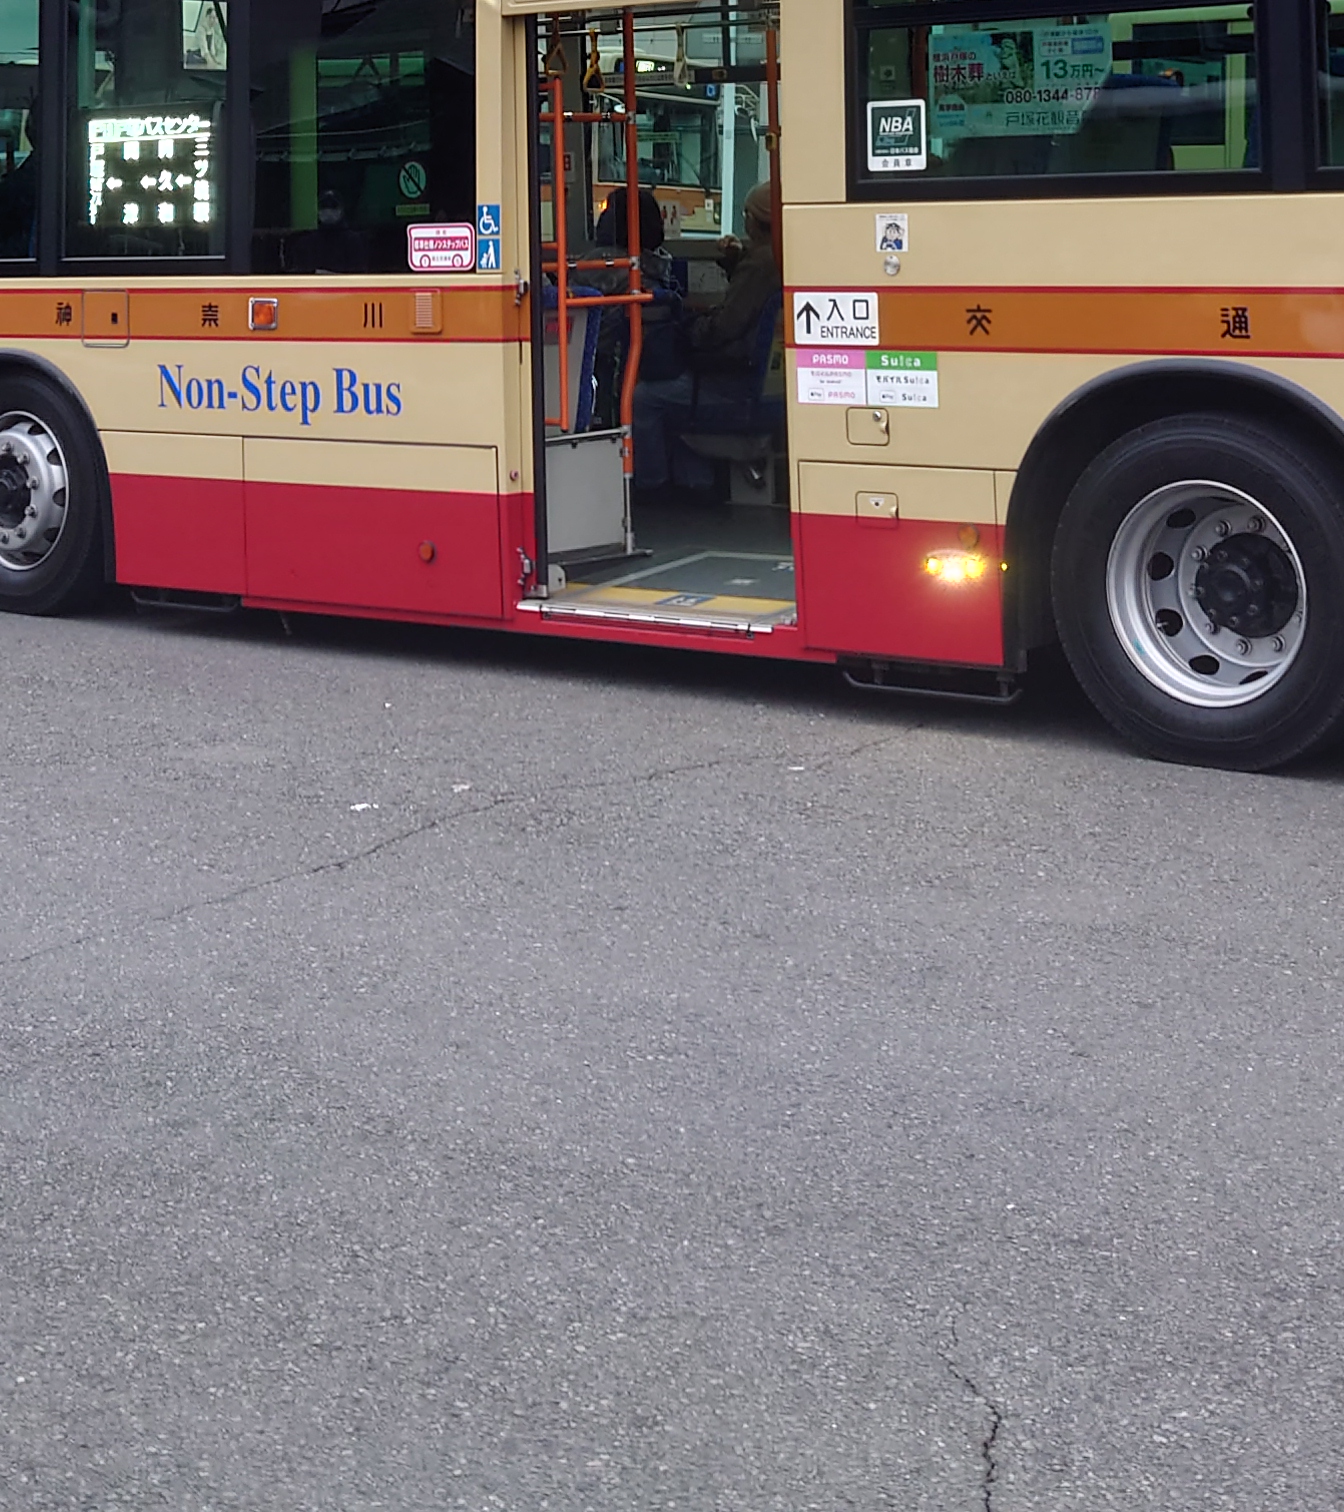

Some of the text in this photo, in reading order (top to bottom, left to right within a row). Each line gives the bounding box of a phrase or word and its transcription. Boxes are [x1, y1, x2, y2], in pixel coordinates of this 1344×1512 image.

[878, 116, 914, 133] NBA
[826, 298, 870, 321] 入口
[820, 325, 877, 339] ENTRANCE
[812, 353, 849, 365] PASMO
[880, 354, 922, 367] Suica
[157, 364, 402, 426] Non-Step Bus
[827, 391, 856, 400] PASMO
[901, 393, 927, 402] Suica
